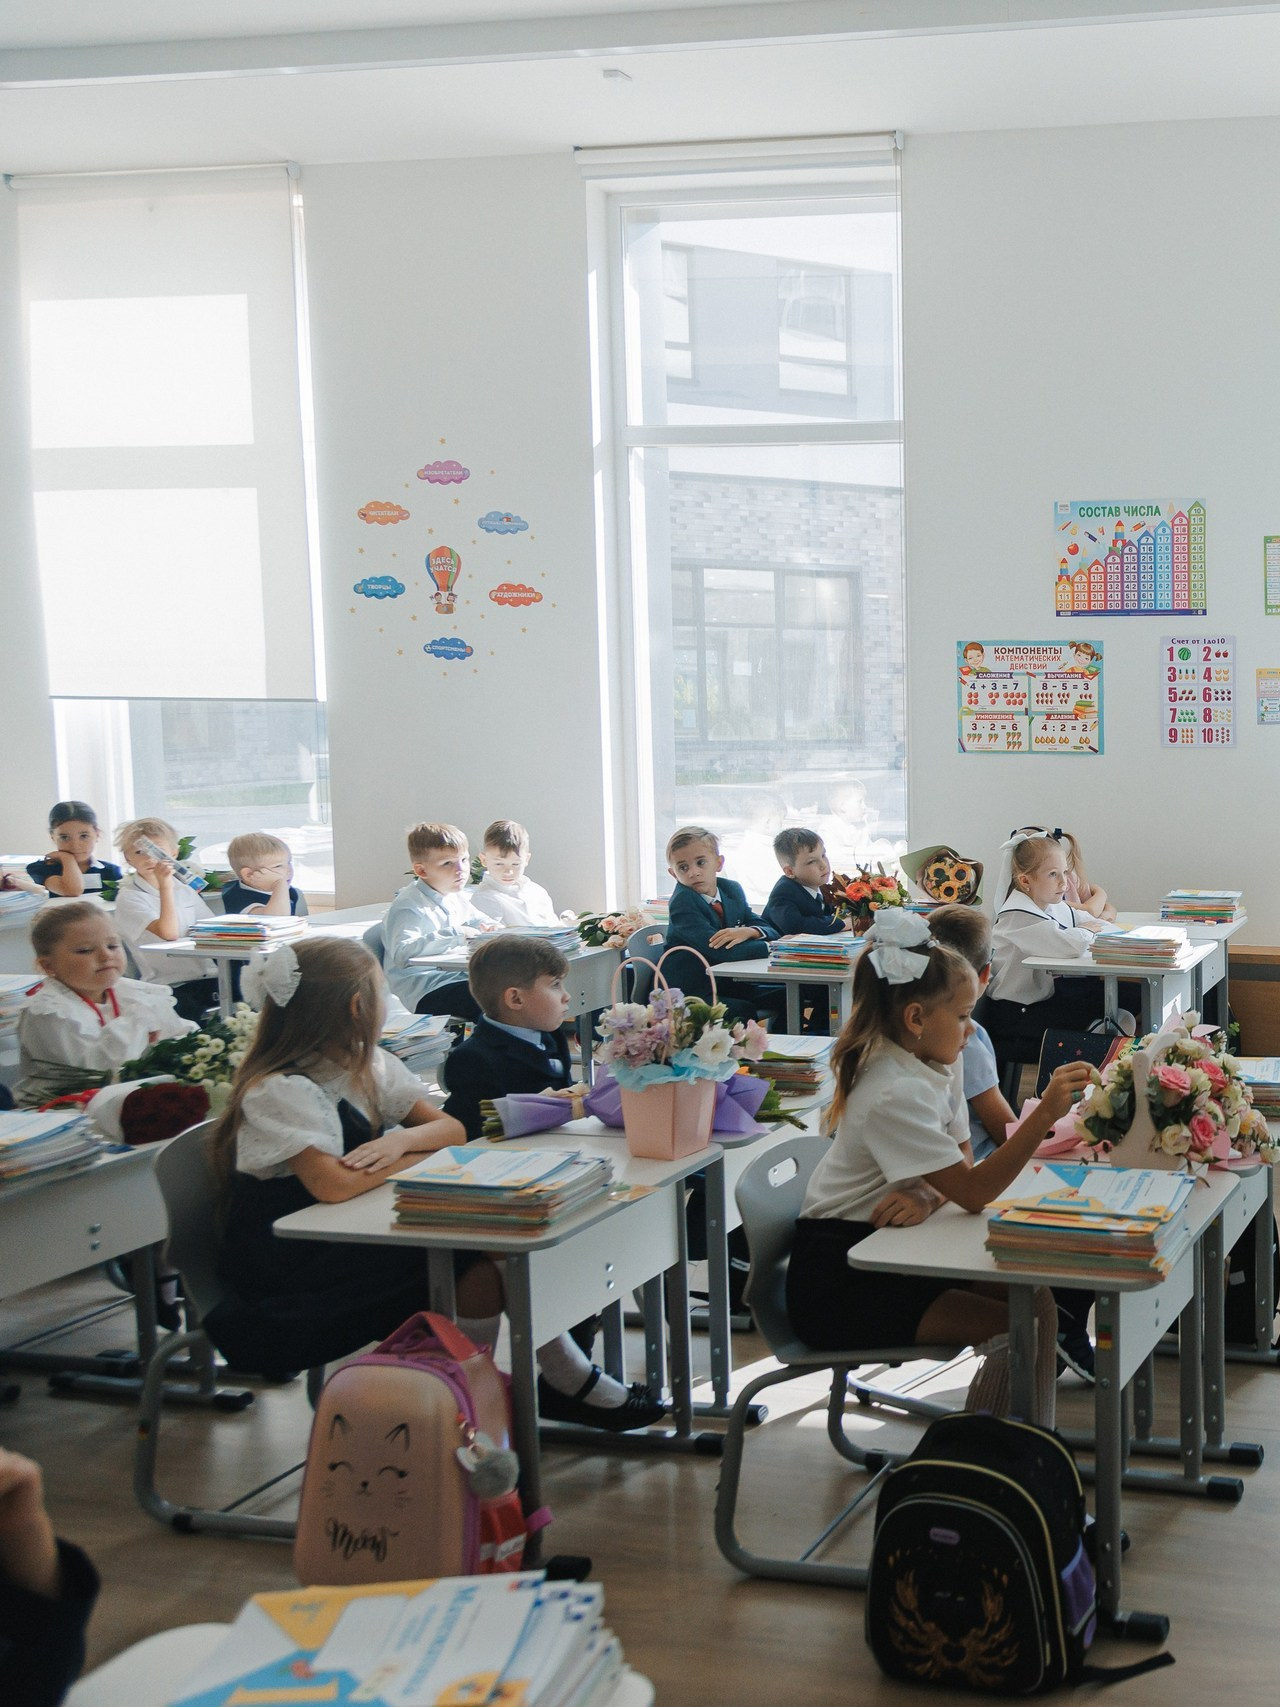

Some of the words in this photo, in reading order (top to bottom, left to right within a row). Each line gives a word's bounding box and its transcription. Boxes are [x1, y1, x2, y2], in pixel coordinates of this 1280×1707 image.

[1078, 506, 1121, 518] СОСТАВ
[1123, 505, 1161, 517] ЧИСЛА
[431, 556, 455, 565] ЗДЕСЬ
[429, 564, 457, 574] УЧАТСЯ
[1171, 637, 1190, 645] Счет
[994, 647, 1062, 655] КОМПОНЕНТЫ
[1167, 646, 1174, 661] 1
[1202, 646, 1211, 661] 2
[1167, 666, 1176, 682] 3
[1203, 667, 1212, 682] 4
[969, 682, 976, 690] 4
[991, 682, 998, 690] 3
[1012, 682, 1019, 690] 7
[1041, 682, 1048, 690] 8
[1061, 682, 1068, 690] 5
[1083, 682, 1089, 690] 3
[1168, 687, 1177, 702] 5
[1202, 687, 1212, 702] 6
[1169, 708, 1177, 723] 7
[1203, 708, 1212, 723] 8
[971, 723, 978, 731] 3
[989, 723, 996, 731] 2
[1011, 723, 1018, 731] 6
[1041, 724, 1048, 732] 4
[1060, 724, 1066, 732] 2
[1081, 724, 1088, 732] 2
[1168, 728, 1178, 743] 9
[1202, 728, 1213, 743] 10
